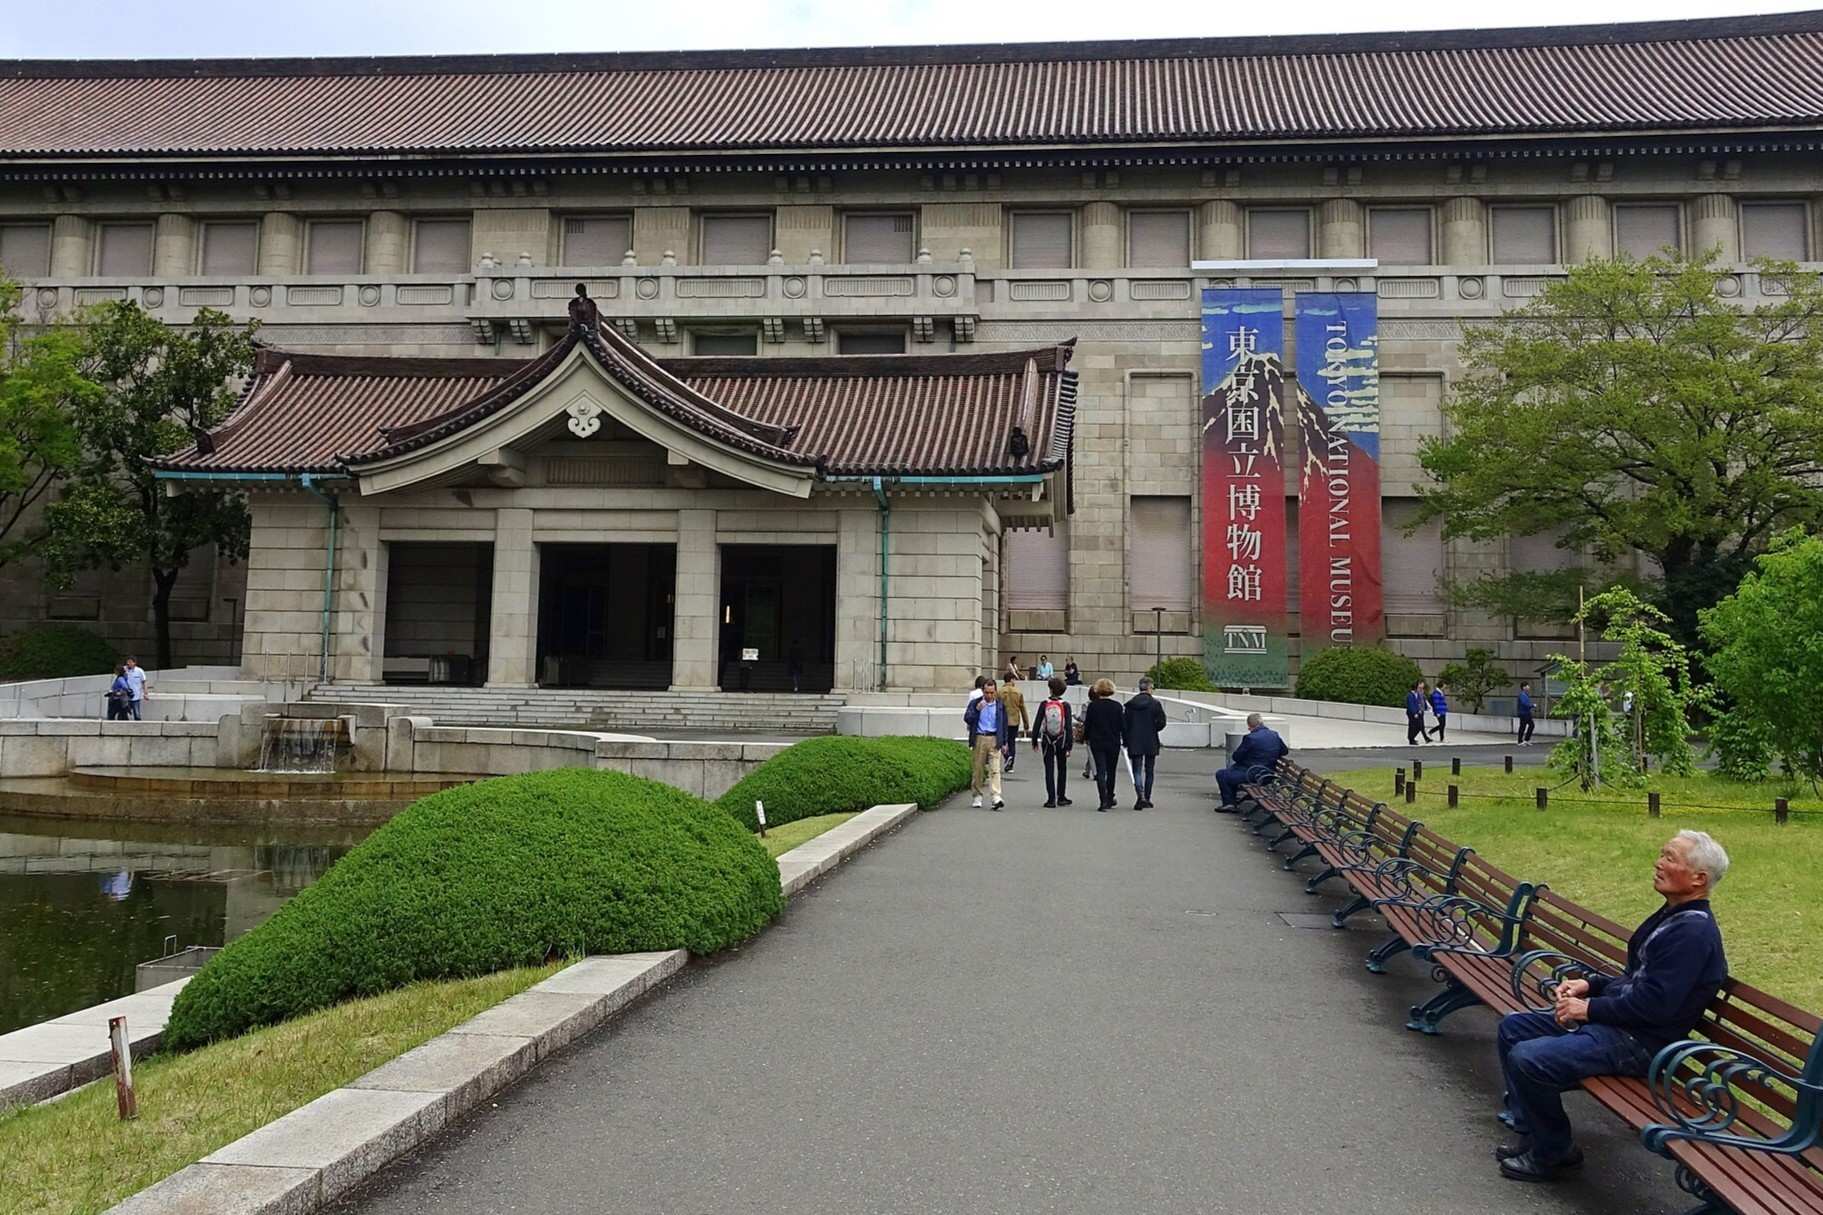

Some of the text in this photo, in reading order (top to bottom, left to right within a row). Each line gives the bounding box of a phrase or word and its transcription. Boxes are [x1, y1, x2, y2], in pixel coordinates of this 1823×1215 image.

[1225, 326, 1262, 601] 東京国立博物館
[1325, 320, 1353, 649] TOKYO NATIONAL MUSEU
[1224, 631, 1266, 649] TNM
